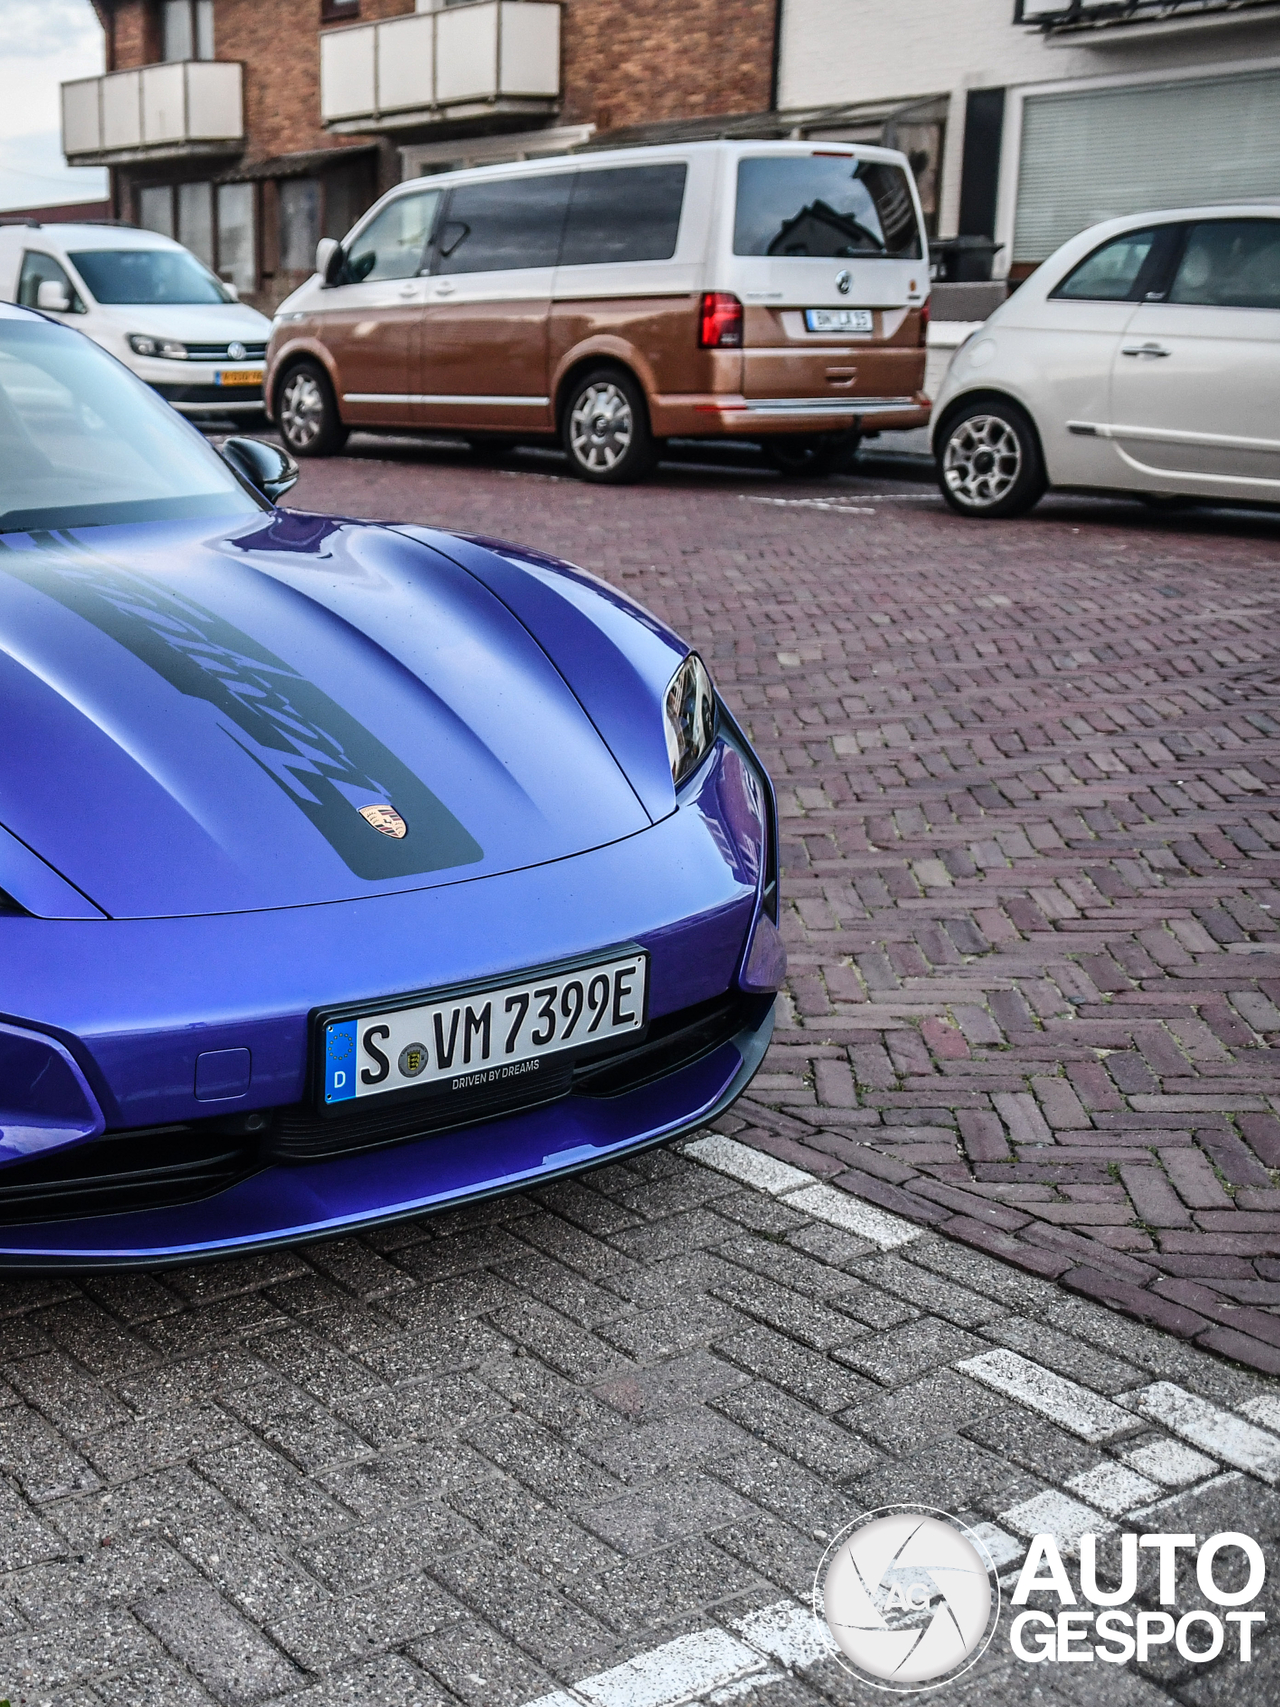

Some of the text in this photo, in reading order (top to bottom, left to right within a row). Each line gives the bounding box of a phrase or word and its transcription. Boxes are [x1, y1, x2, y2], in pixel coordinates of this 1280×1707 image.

[360, 1024, 390, 1086] S
[433, 1001, 491, 1070] VM
[504, 966, 637, 1055] 7399E
[333, 1071, 347, 1089] D
[452, 1059, 540, 1090] DRIVEN BY DREAMS
